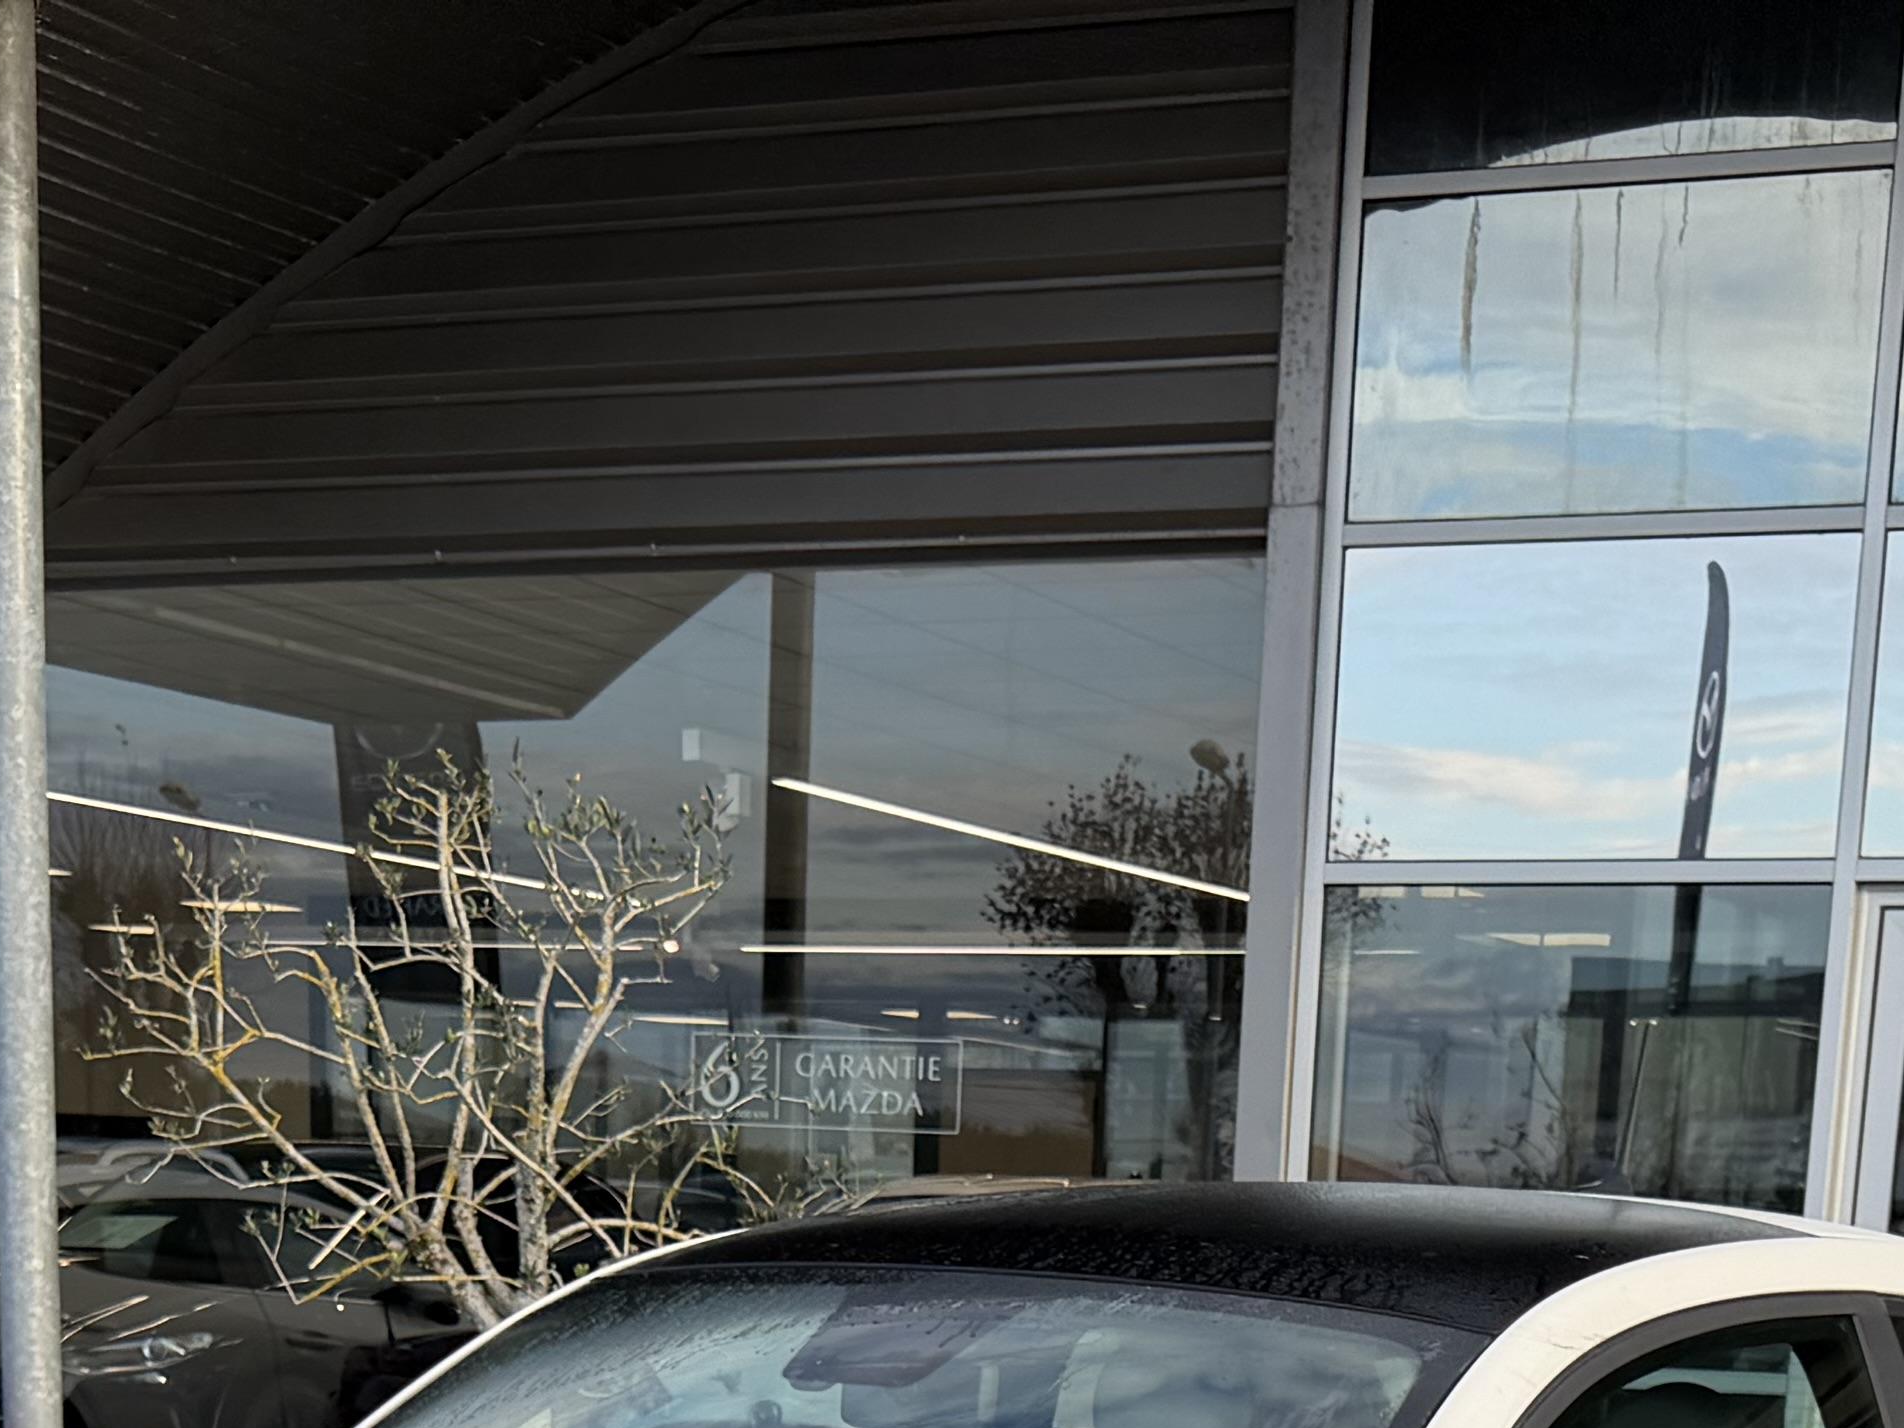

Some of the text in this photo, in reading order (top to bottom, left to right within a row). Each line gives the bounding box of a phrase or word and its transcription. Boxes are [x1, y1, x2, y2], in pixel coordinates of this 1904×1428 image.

[700, 1040, 741, 1107] 6
[796, 1053, 941, 1082] GARANTIE
[812, 1088, 924, 1118] MAZDA
